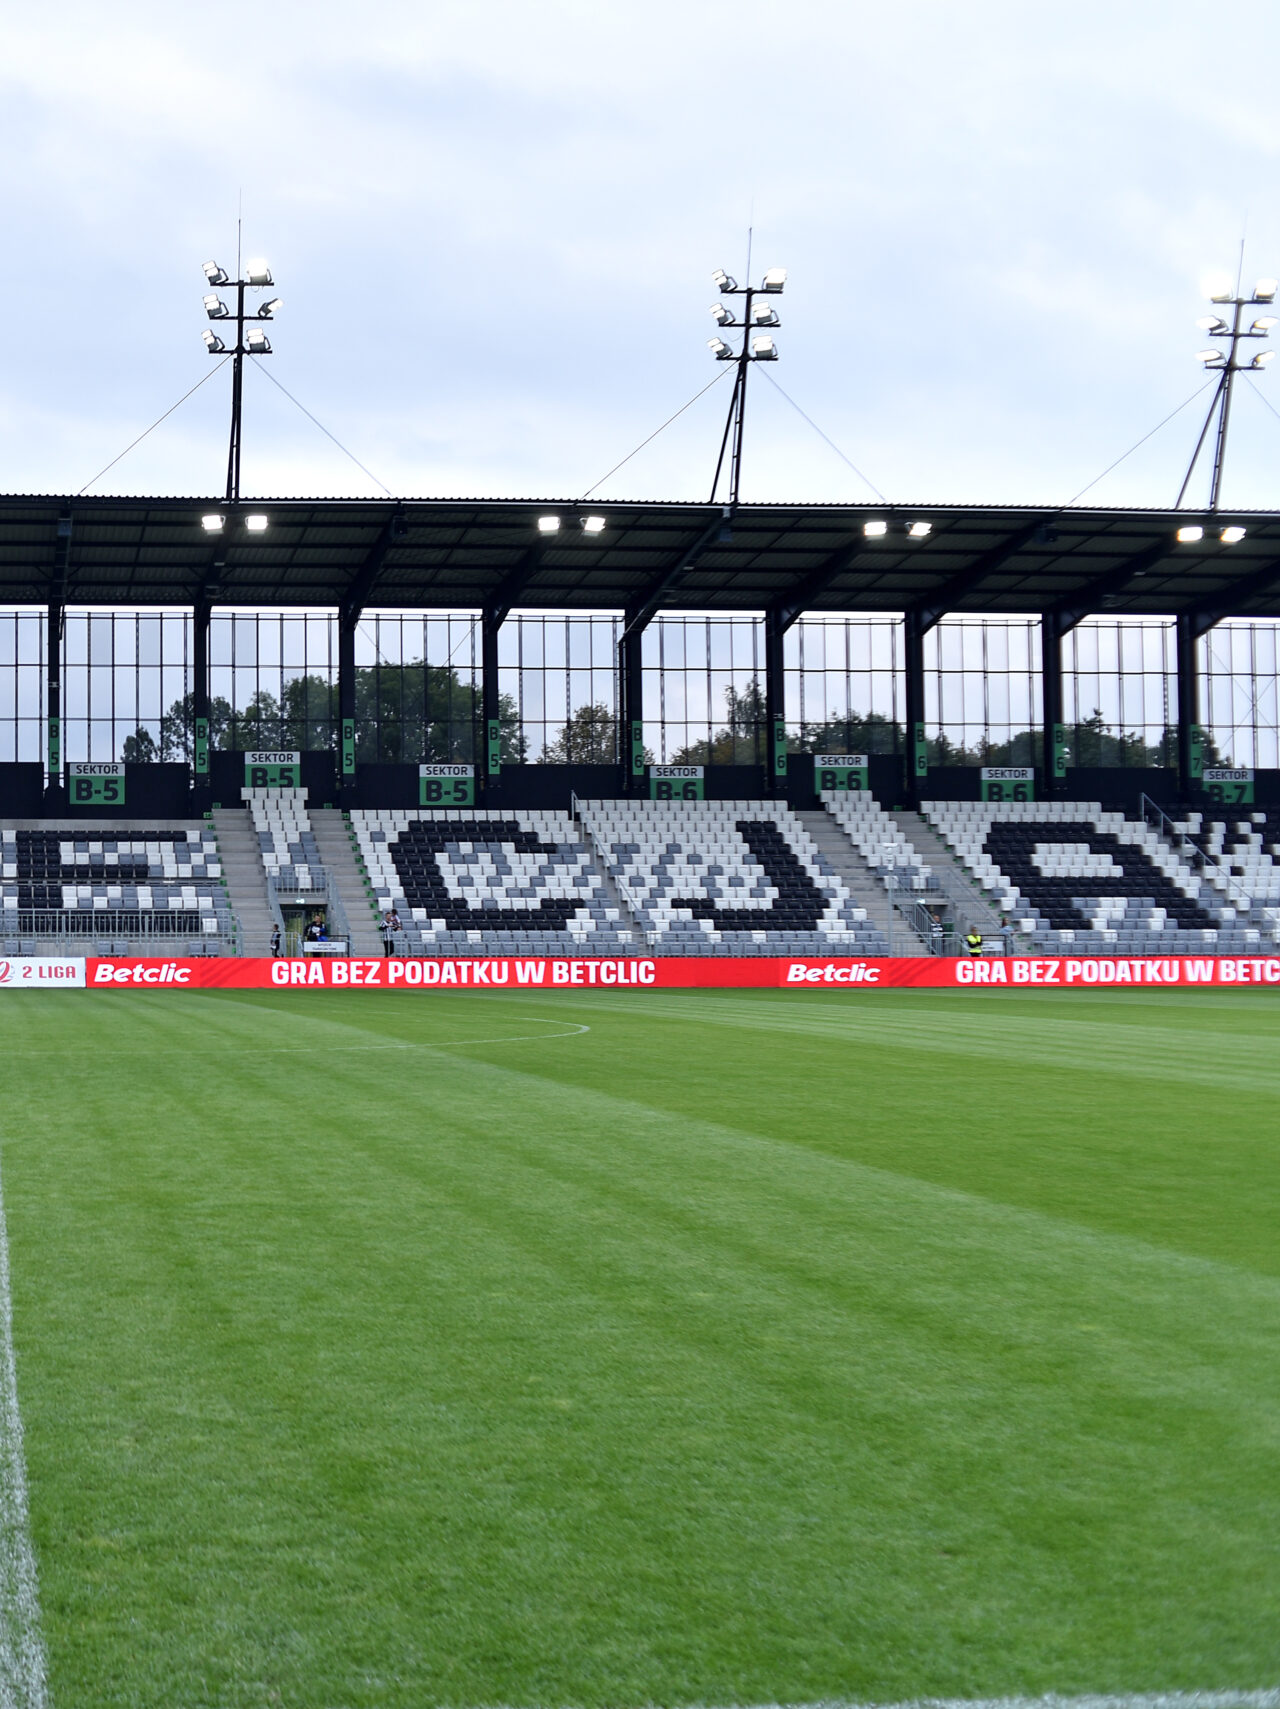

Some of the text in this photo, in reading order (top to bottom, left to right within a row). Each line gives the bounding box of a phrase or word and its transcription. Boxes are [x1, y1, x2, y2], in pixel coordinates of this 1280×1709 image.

[251, 753, 294, 763] SEKTOR
[821, 756, 862, 766] SEKTOR
[76, 765, 119, 775] SEKTOR
[251, 767, 294, 787] B-5
[425, 766, 468, 776] SEKTOR
[656, 767, 698, 777] SEKTOR
[987, 769, 1028, 779] SEKTOR
[1208, 771, 1248, 780] SEKTOR
[821, 770, 862, 791] B-6
[75, 779, 119, 801] B-5
[425, 780, 468, 801] B-5
[655, 781, 698, 800] B-6
[988, 783, 1028, 801] B-6
[22, 965, 76, 979] 2 LIGA
[94, 963, 192, 983] Betclic
[272, 960, 655, 984] GRA BEZ PODATKU W BETCLIC
[787, 963, 881, 982] Betclic
[956, 960, 1008, 984] GRA
[1013, 960, 1060, 983] BEZ
[1066, 960, 1180, 983] PODATKU
[1185, 960, 1215, 982] W
